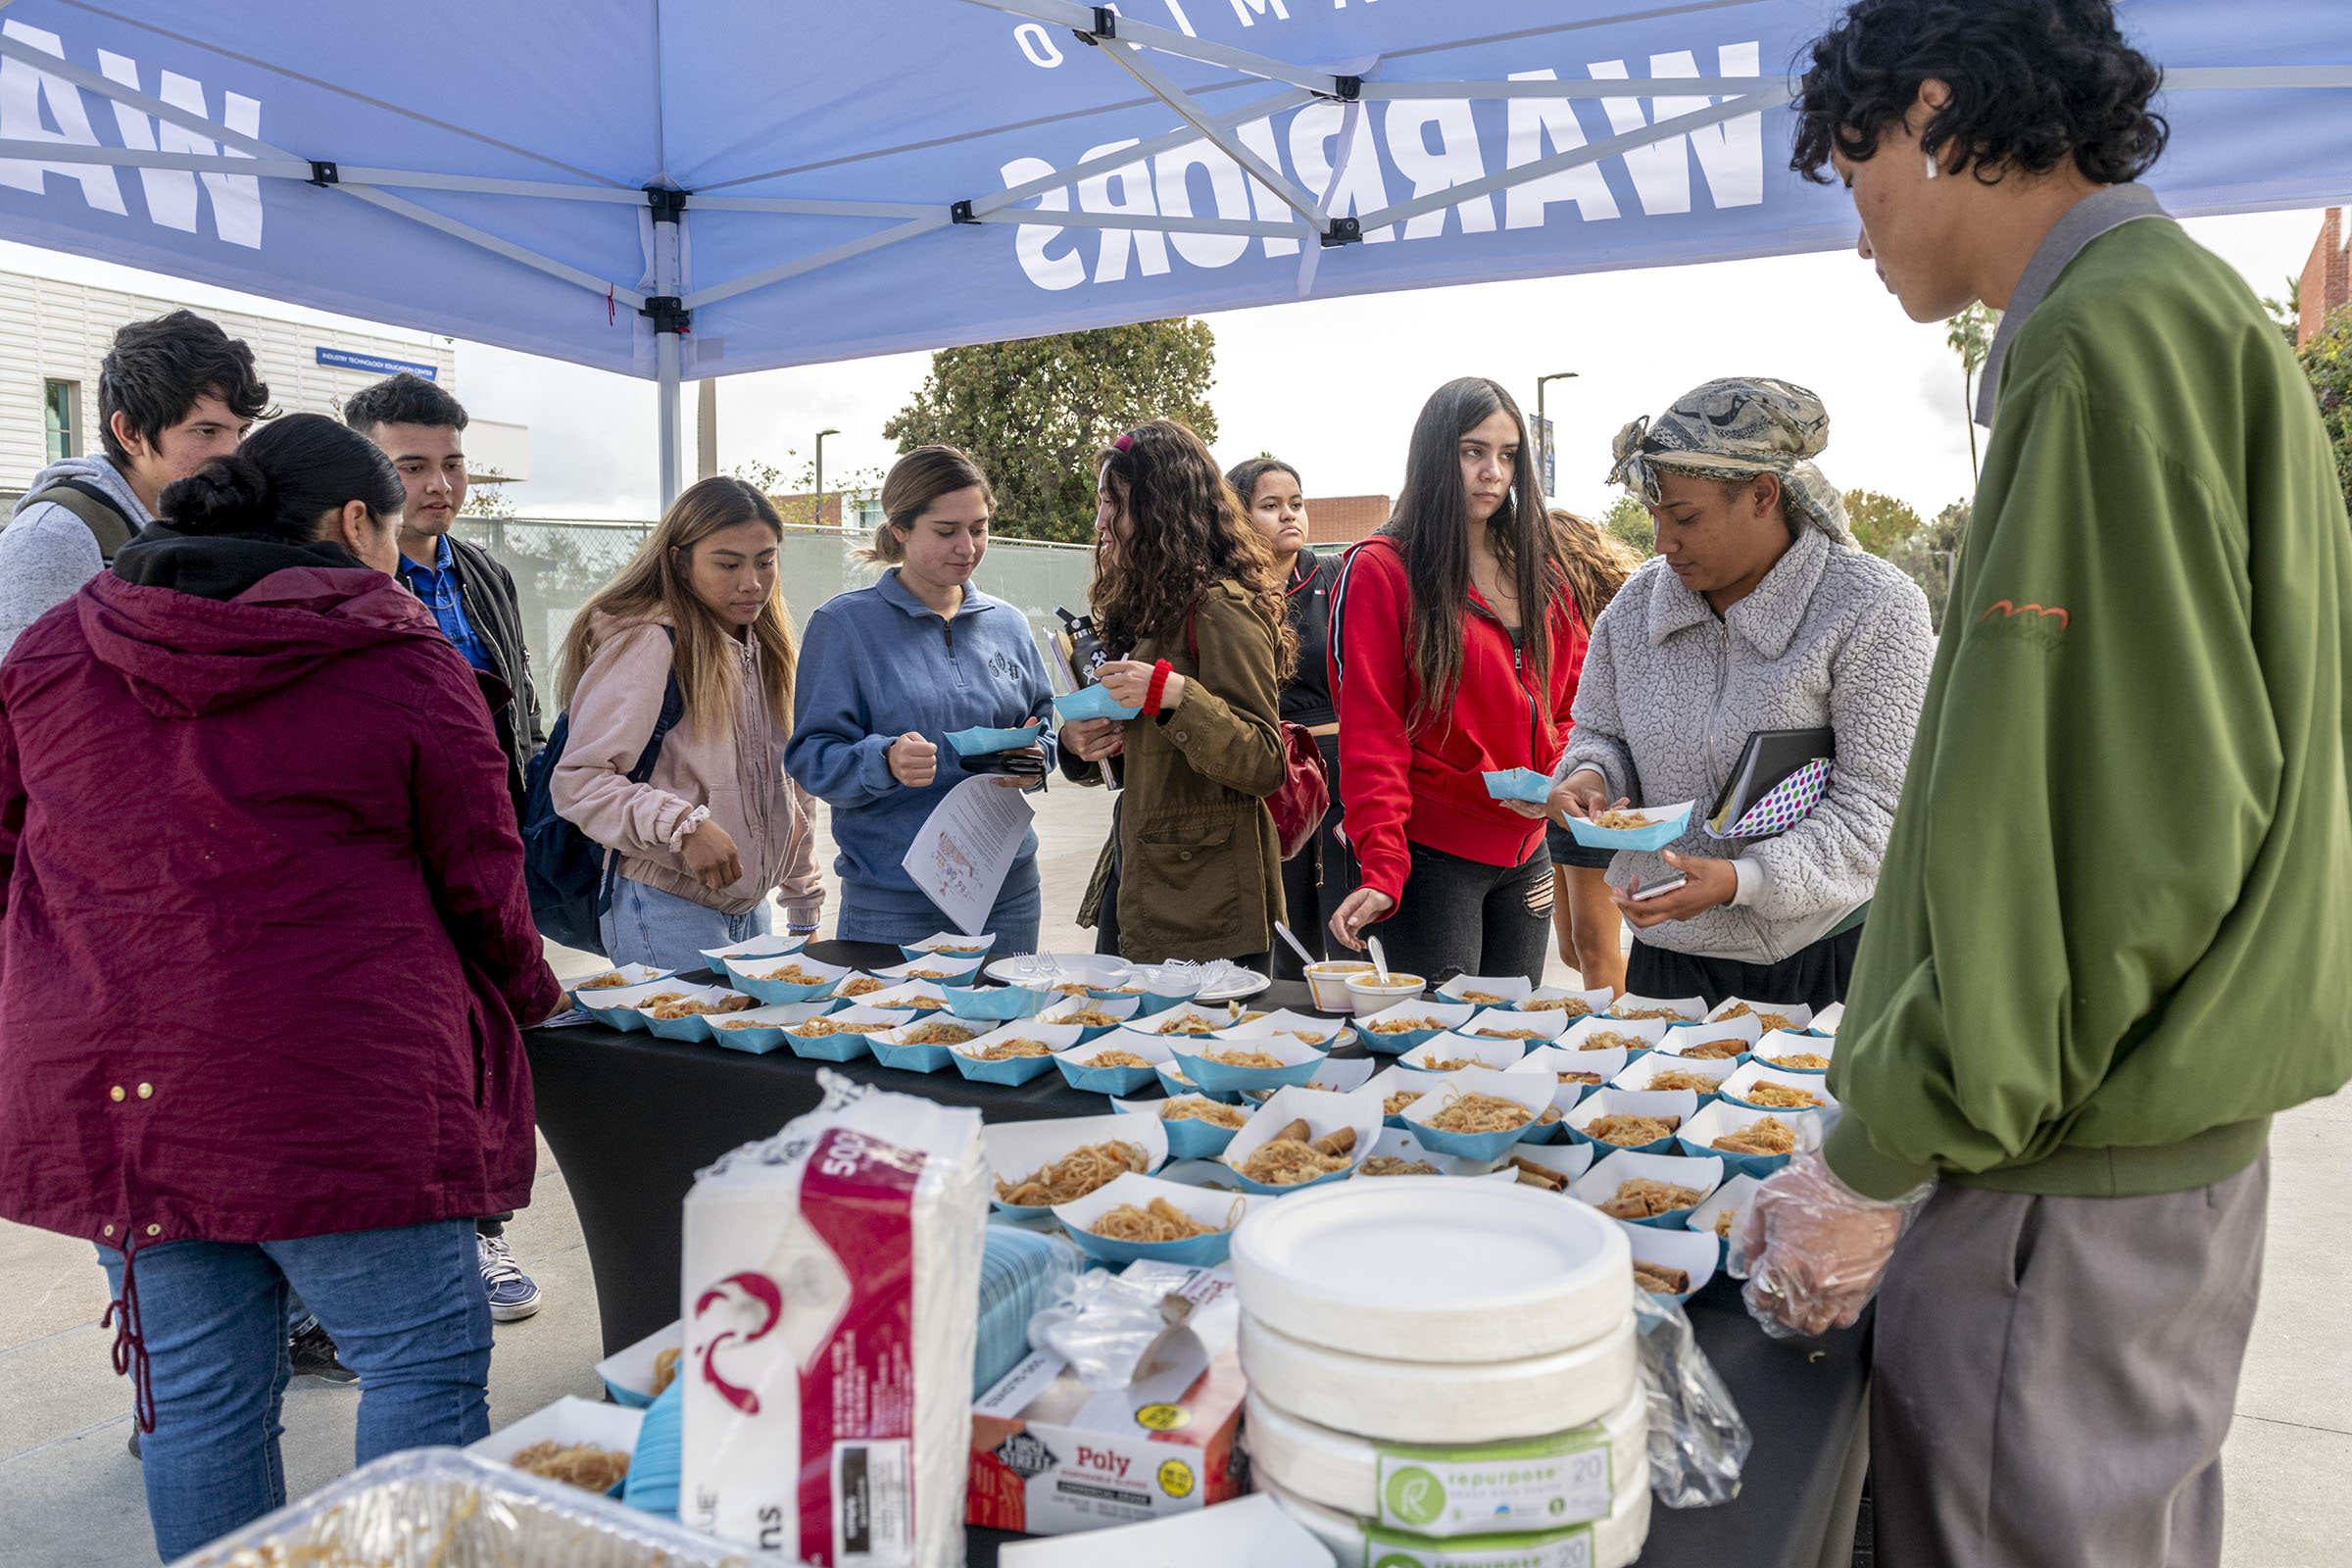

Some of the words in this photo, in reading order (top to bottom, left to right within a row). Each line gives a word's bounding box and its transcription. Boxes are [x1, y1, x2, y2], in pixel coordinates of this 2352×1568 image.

[321, 352, 348, 363] INDUSTRY
[348, 356, 384, 368] TECHNOLOGY
[384, 363, 414, 373] EDUCATION
[414, 367, 433, 376] CENTER
[1077, 1446, 1131, 1477] Poly
[1572, 1455, 1602, 1484] 20
